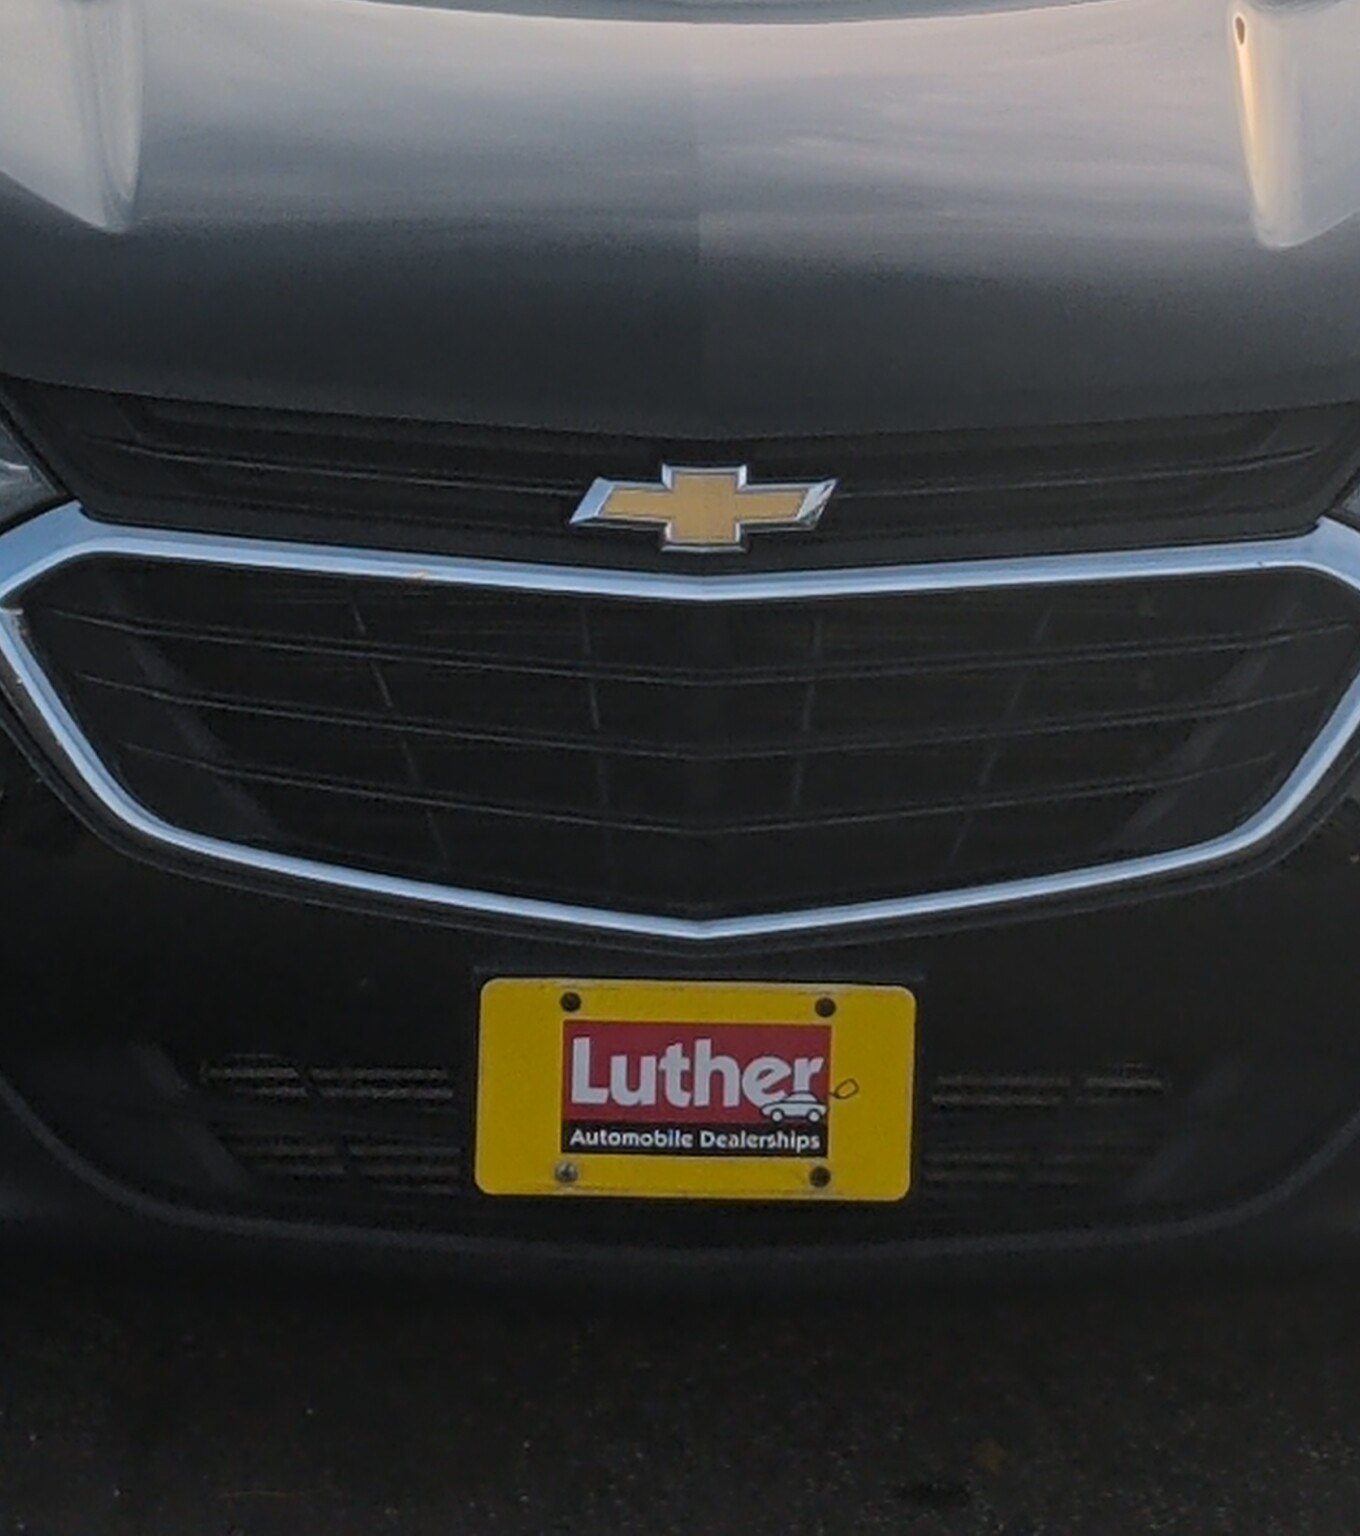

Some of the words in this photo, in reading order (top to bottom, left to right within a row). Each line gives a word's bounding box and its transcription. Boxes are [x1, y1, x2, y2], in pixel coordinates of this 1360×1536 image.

[570, 1036, 825, 1109] Luther
[569, 1127, 694, 1149] Automobile
[699, 1129, 822, 1154] Dealerships
